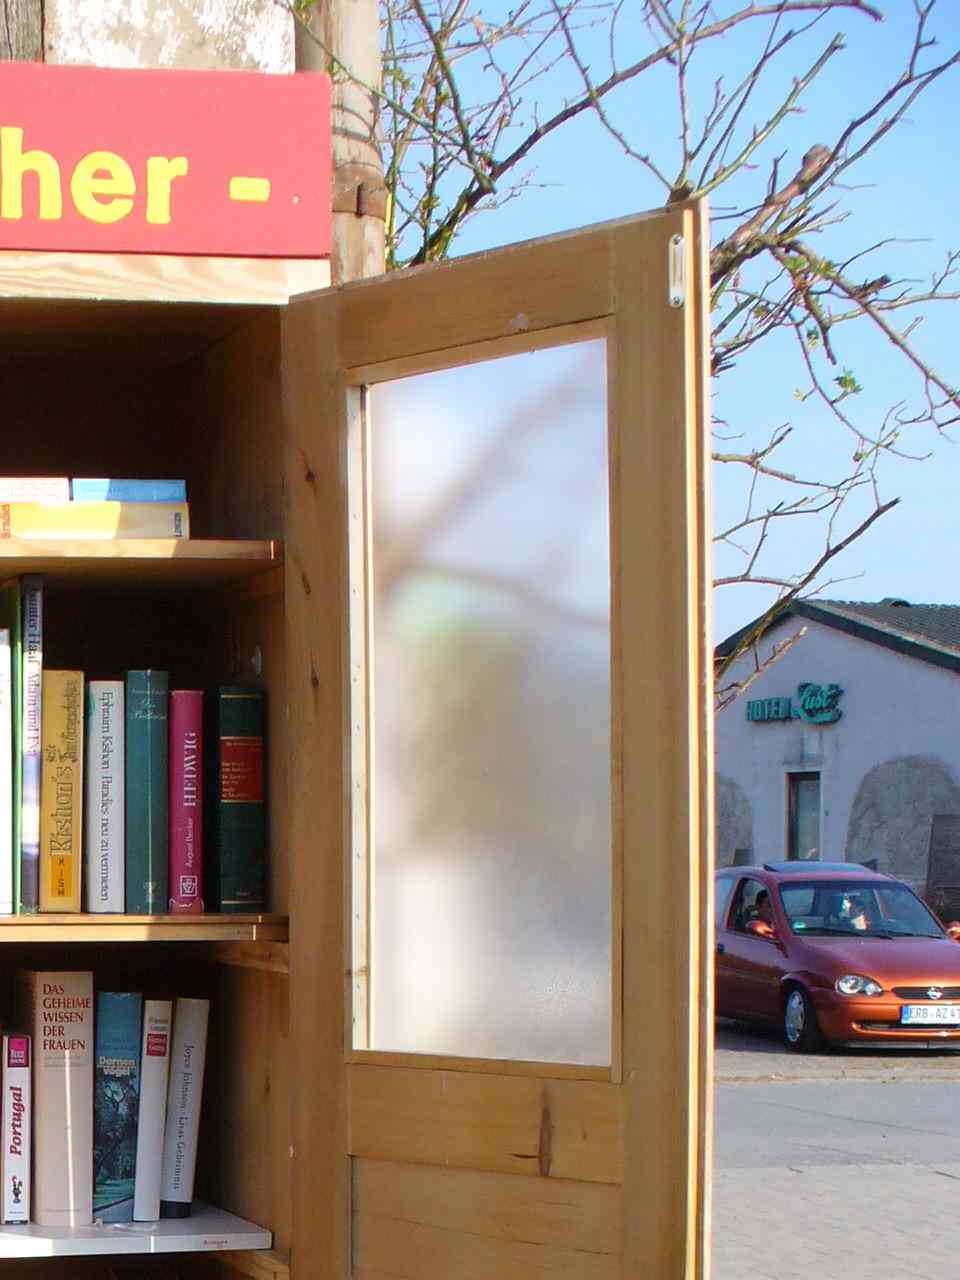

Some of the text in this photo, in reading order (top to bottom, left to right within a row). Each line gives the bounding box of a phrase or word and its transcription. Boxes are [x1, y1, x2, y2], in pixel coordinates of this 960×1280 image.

[27, 673, 41, 706] Adam
[27, 709, 41, 732] und
[27, 733, 41, 759] Eva
[182, 732, 197, 807] HEDWIG
[100, 691, 115, 902] Ephraim Kishon Paradies neu zu vermieten
[48, 766, 73, 856] Kishon's
[43, 983, 65, 995] DAS
[42, 998, 91, 1010] GEHEIME
[43, 1012, 84, 1024] WISSEN
[43, 1025, 65, 1037] DER
[43, 1039, 86, 1051] FRAUEN
[183, 1042, 196, 1068] Joyce
[179, 1072, 191, 1109] Johnson
[8, 1086, 25, 1156] Portugal
[172, 1141, 186, 1190] Geheimnis
